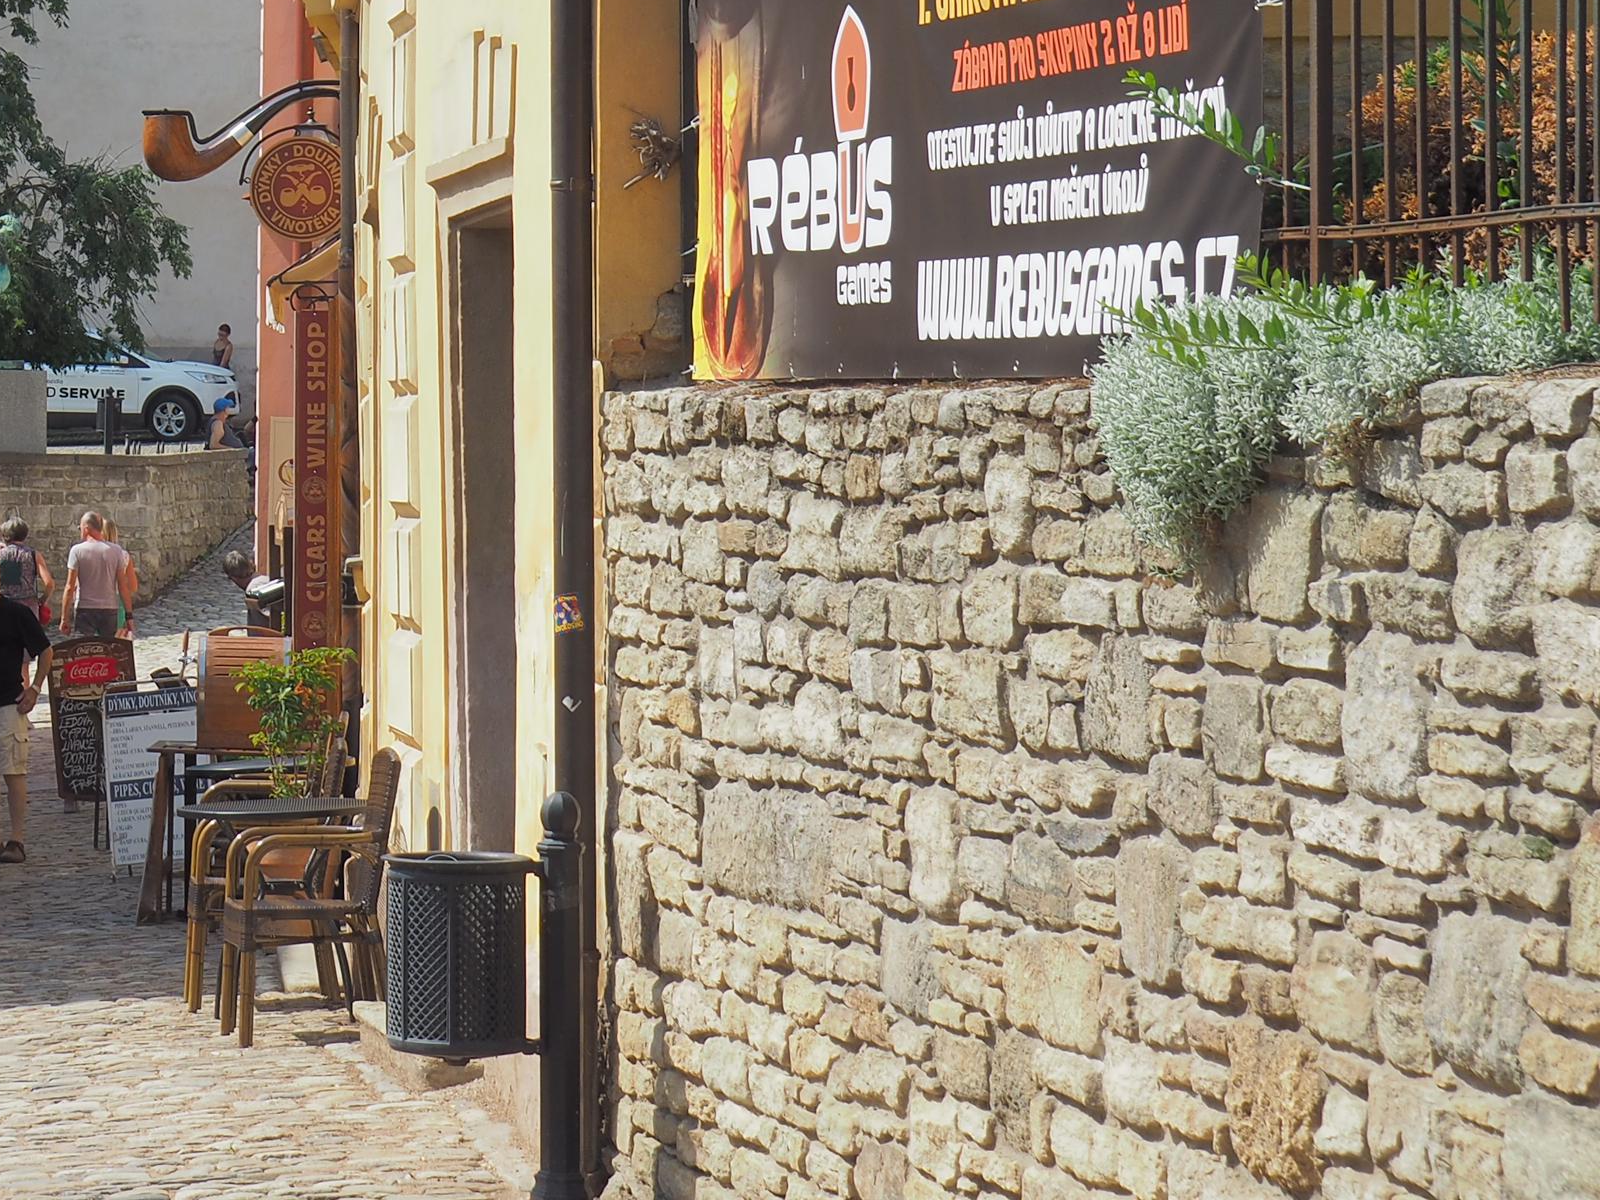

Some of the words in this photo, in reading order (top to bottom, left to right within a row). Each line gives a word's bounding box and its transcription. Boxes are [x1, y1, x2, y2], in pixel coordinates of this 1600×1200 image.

[951, 39, 1008, 93] ZÁBAVA
[1008, 35, 1037, 83] PRO
[1036, 22, 1099, 77] SKUPINY
[1100, 19, 1116, 66] 2
[1117, 0, 1142, 63] AŽ
[1142, 10, 1155, 58] 8
[1084, 108, 1097, 151] A
[917, 235, 1239, 341] WWW.REBUSGAMESCZ
[307, 322, 326, 391] SHOP
[59, 386, 125, 400] SERVIE
[307, 402, 326, 468] WINE
[306, 514, 326, 602] CIGARS
[108, 695, 138, 712] DÝMKY,
[138, 689, 180, 708] DOUTNÍKY,
[114, 781, 142, 798] PIPES,
